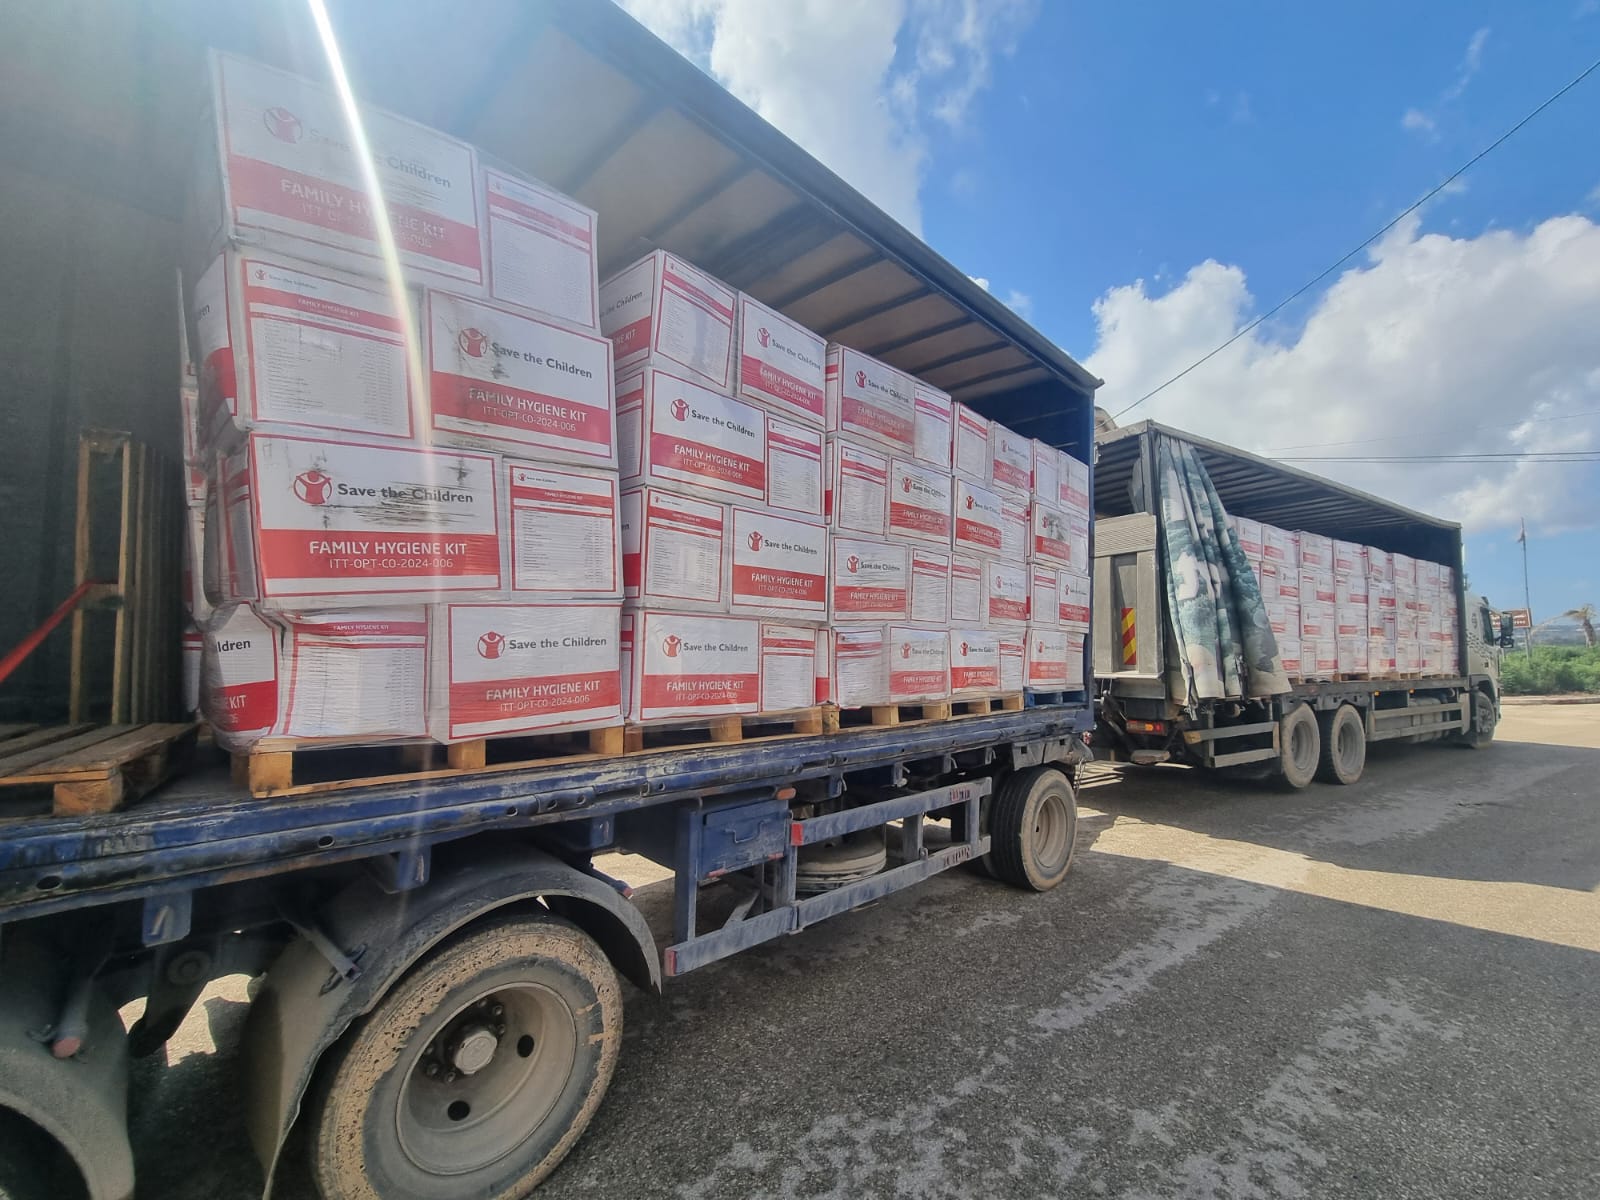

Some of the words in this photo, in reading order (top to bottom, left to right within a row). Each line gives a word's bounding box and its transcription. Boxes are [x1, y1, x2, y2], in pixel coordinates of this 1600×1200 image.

[387, 155, 451, 188] Children
[280, 178, 344, 208] FAMILY
[491, 342, 520, 359] Save
[523, 352, 543, 365] the
[546, 358, 592, 379] Children
[469, 387, 513, 407] FAMILY
[517, 398, 567, 418] HYGIENE
[570, 410, 588, 422] KIT
[482, 406, 576, 431] ITT-OPT-CO-2024-006
[692, 410, 710, 422] Save
[712, 415, 725, 427] the
[726, 421, 755, 438] Children
[674, 445, 704, 458] FAMILY
[705, 452, 738, 469] HYGIENE
[739, 462, 751, 472] KIT
[337, 483, 376, 497] Save
[380, 487, 407, 498] the
[412, 488, 473, 503] Children
[309, 541, 370, 555] FAMILY
[374, 542, 441, 555] HYGIENE
[444, 542, 468, 555] KIT
[764, 539, 780, 548] Save
[793, 544, 818, 555] Children
[329, 558, 454, 569] ITT-OPT-CO-2024-006
[751, 573, 776, 583] FAMILY
[776, 576, 804, 587] HYGIENE
[804, 579, 814, 588] KIT
[217, 640, 251, 652] ldren
[509, 639, 537, 650] Save
[540, 638, 559, 648] the
[562, 637, 607, 648] Children
[683, 642, 702, 651] Save
[704, 643, 717, 652] the
[718, 643, 748, 652] Children
[486, 687, 530, 701] FAMILY
[533, 682, 581, 697] HYGIENE
[584, 680, 600, 691] KIT
[666, 681, 697, 691] FAMILY
[699, 680, 731, 690] HYGIENE
[733, 680, 744, 689] KIT
[229, 695, 247, 709] KIT
[500, 694, 590, 712] ITT-OPT-CO-2024-006
